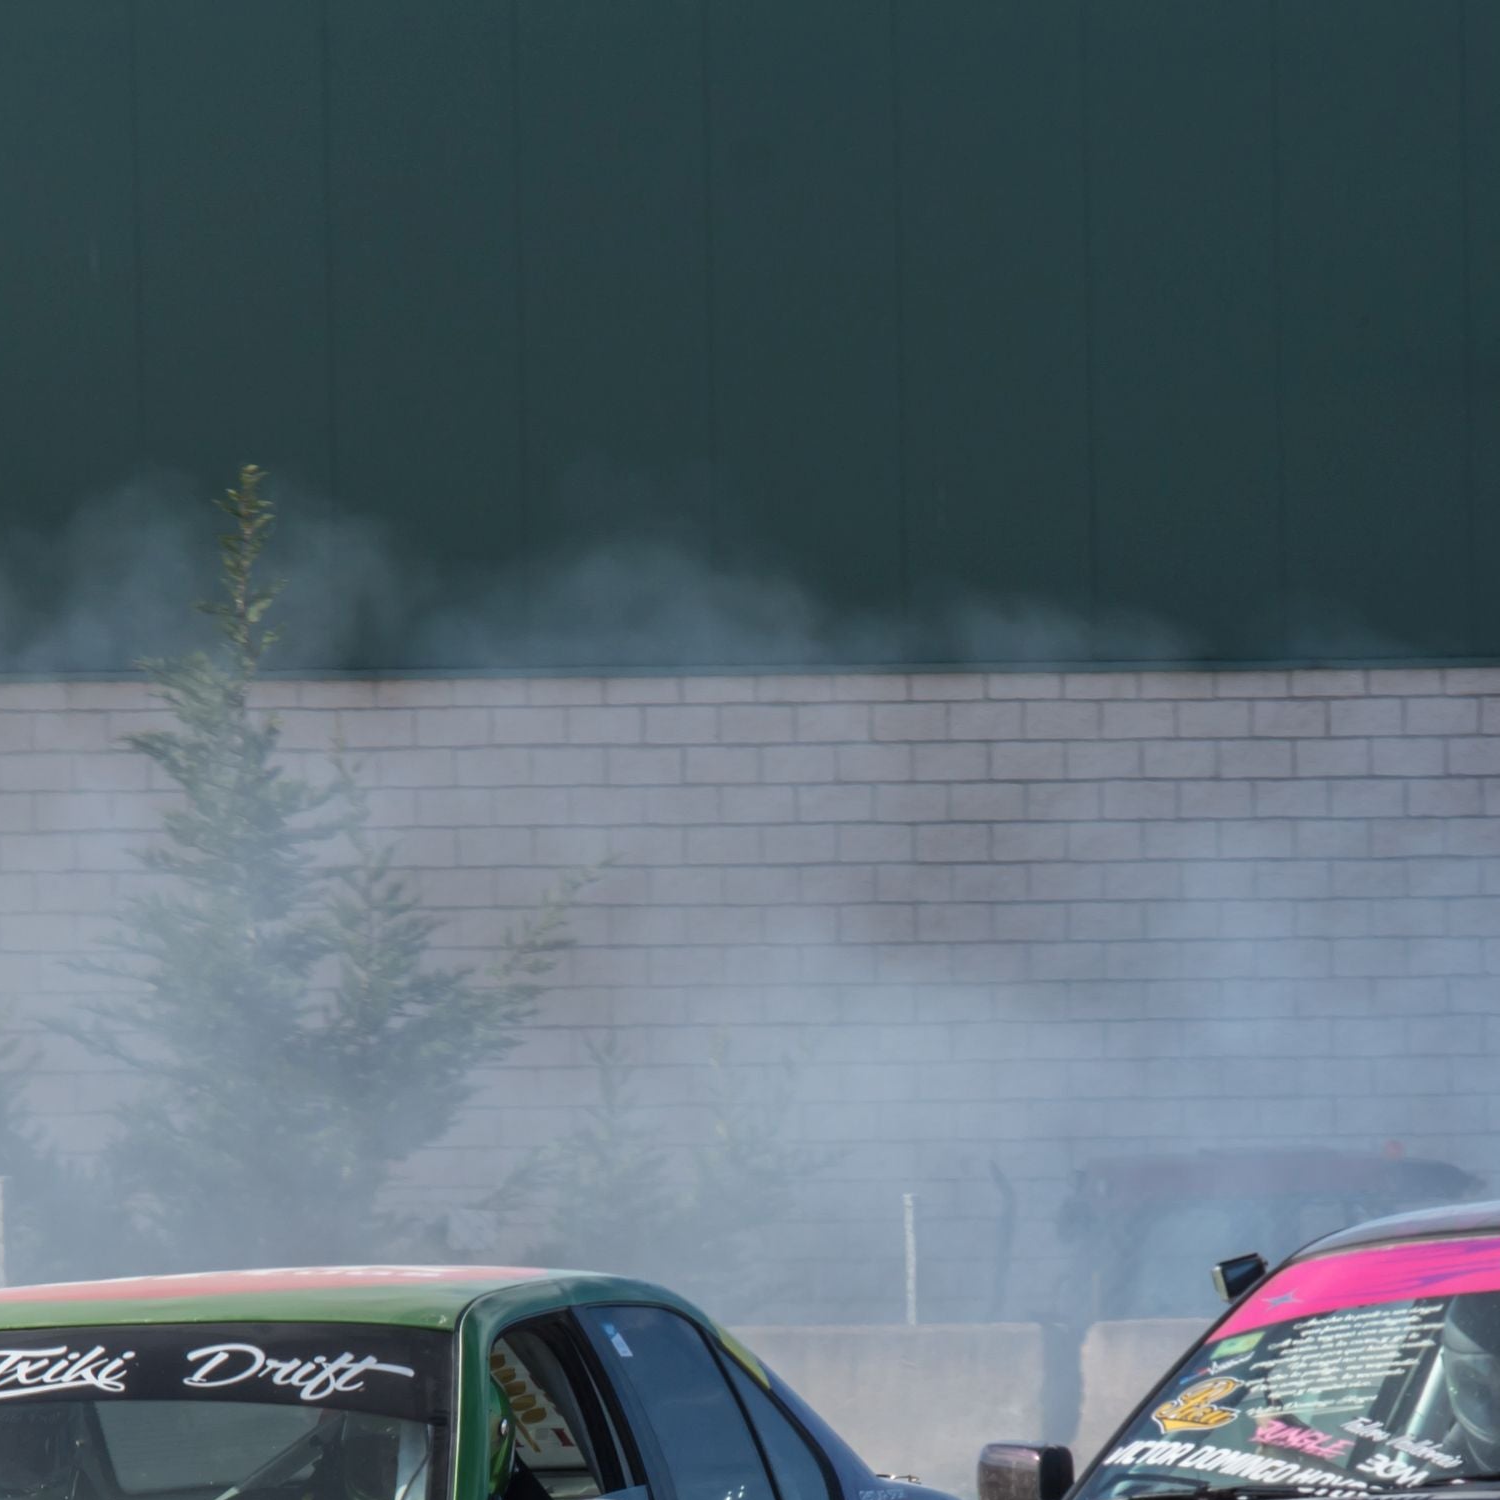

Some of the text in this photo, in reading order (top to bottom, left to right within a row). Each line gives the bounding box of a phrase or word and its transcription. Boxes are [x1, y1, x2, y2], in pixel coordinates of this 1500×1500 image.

[183, 1343, 415, 1401] Drift
[1103, 1441, 1195, 1467] VICTOR
[1179, 1445, 1301, 1483] DOMINGO
